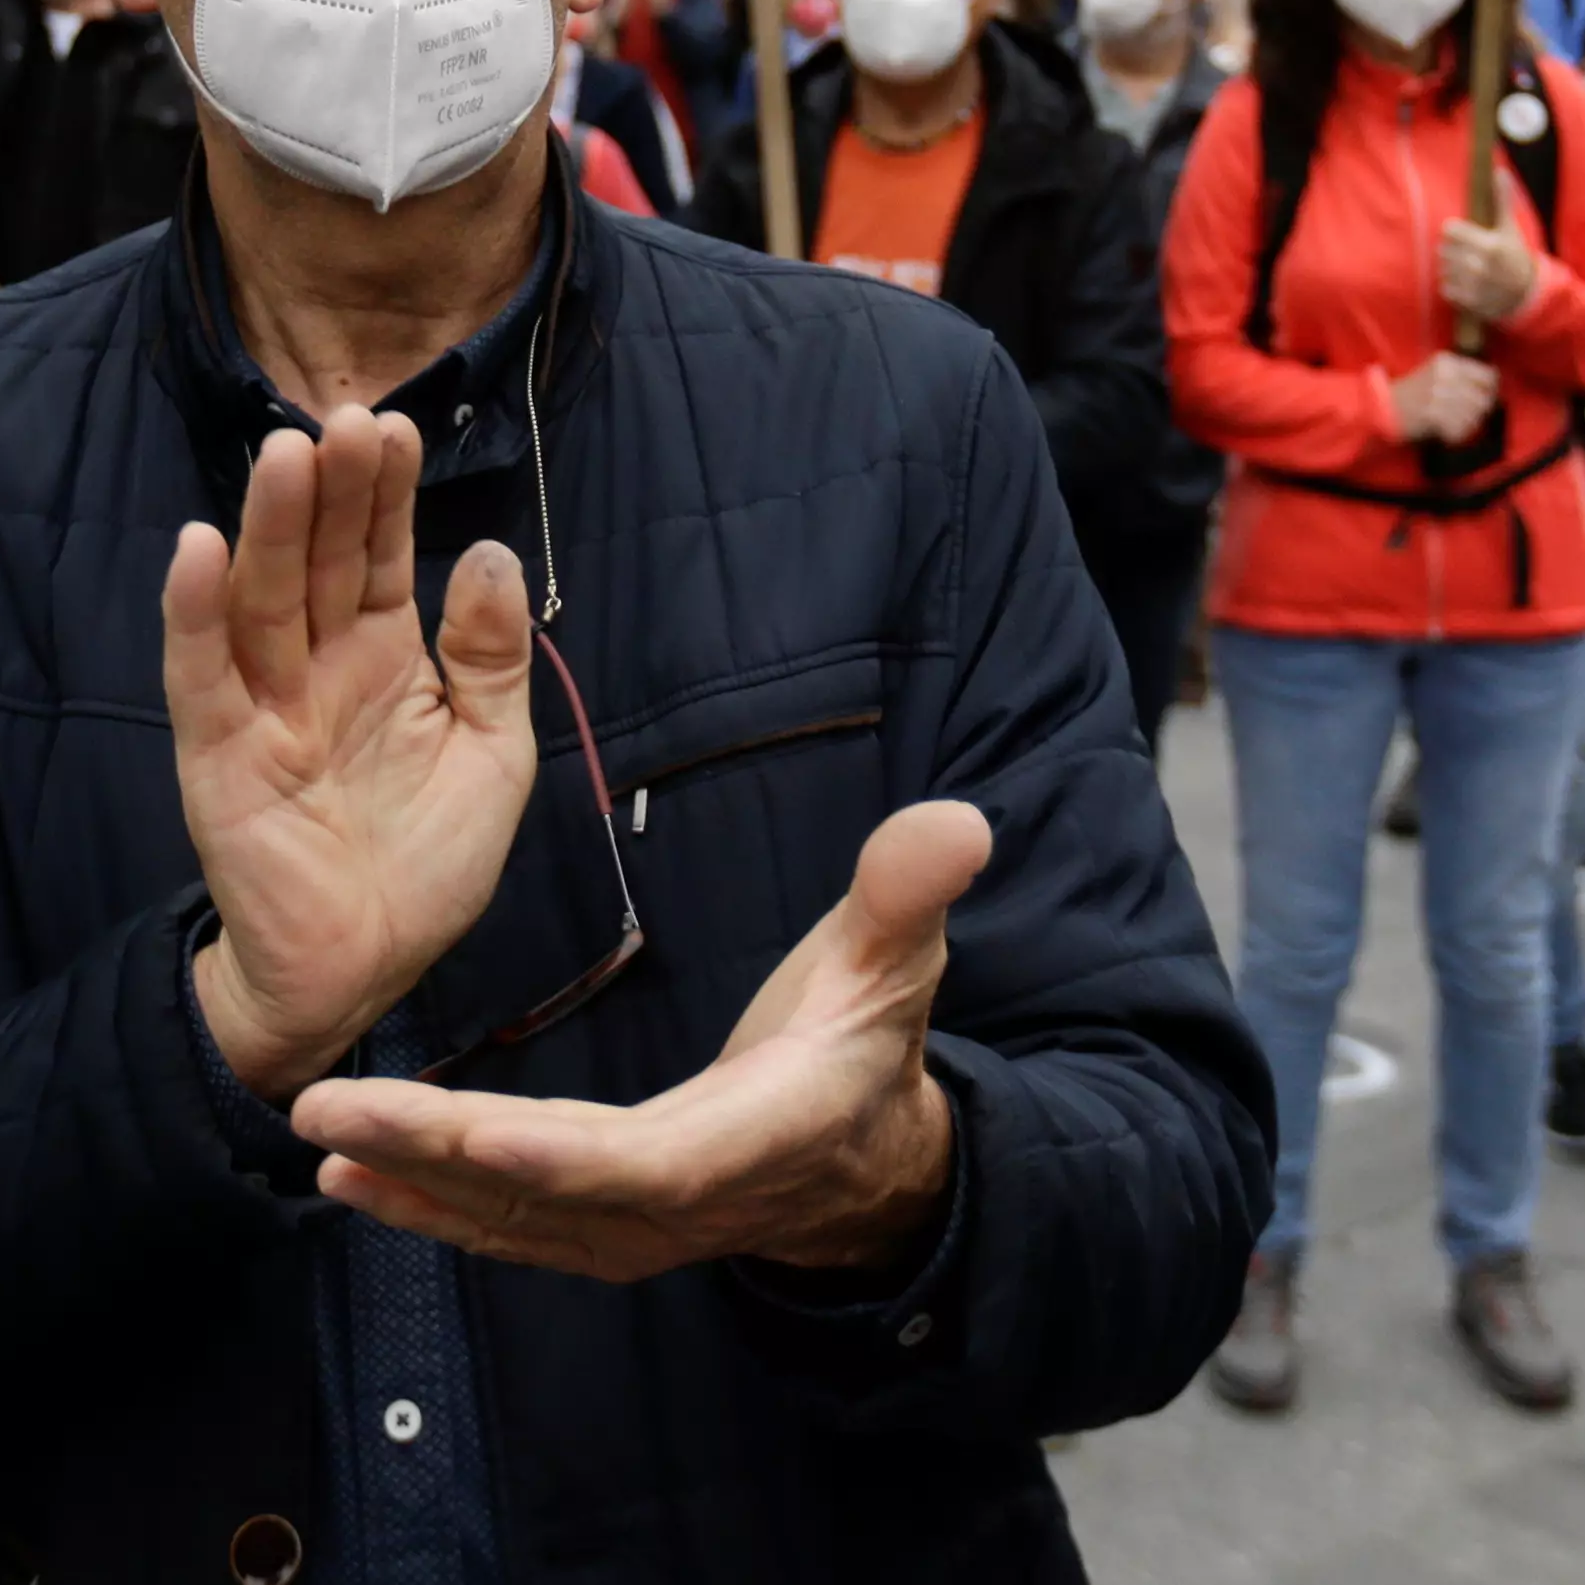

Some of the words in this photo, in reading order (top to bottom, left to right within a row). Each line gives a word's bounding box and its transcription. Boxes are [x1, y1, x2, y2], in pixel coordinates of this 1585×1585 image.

[417, 33, 450, 55] VENUS
[440, 54, 466, 78] FFP2
[468, 48, 488, 68] NR
